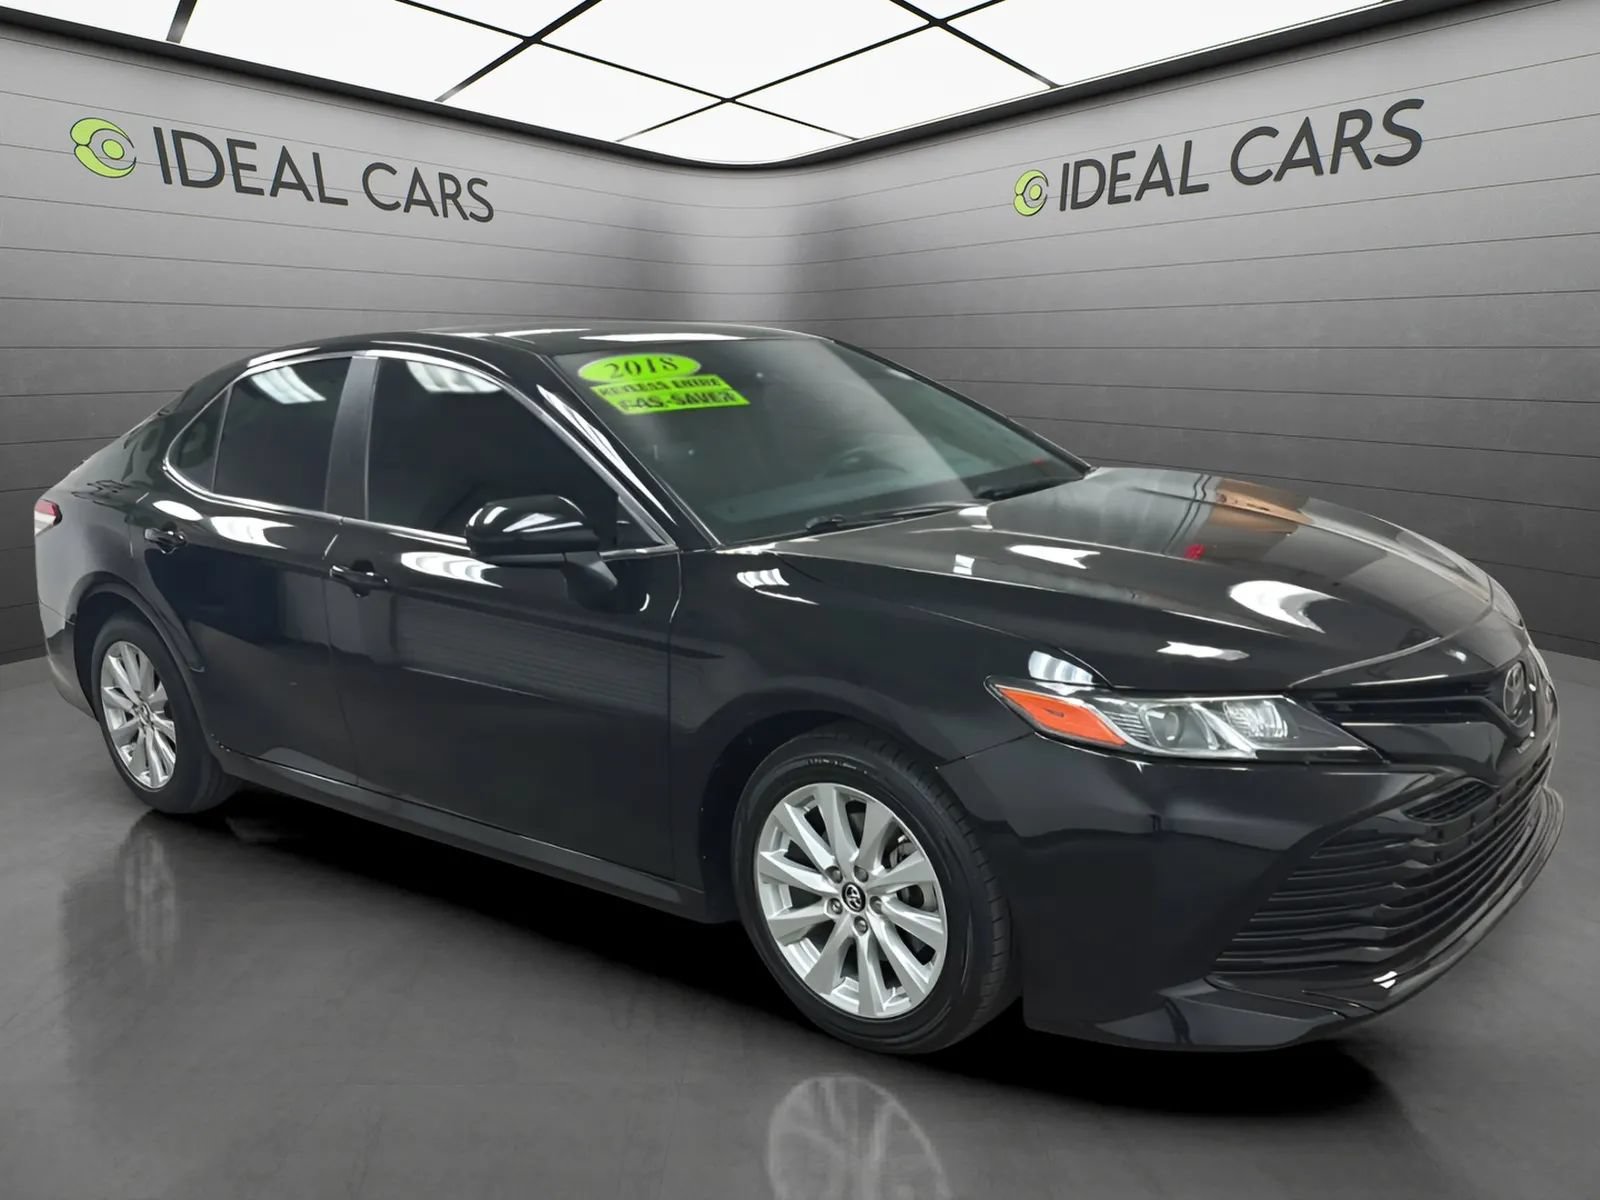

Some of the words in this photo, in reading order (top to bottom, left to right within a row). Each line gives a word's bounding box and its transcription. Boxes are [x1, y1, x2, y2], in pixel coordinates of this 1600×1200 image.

[153, 126, 348, 206] IDEAL
[362, 162, 494, 223] CARS
[1059, 140, 1209, 212] IDEAL
[1230, 98, 1424, 186] CARS
[604, 356, 679, 379] 2018
